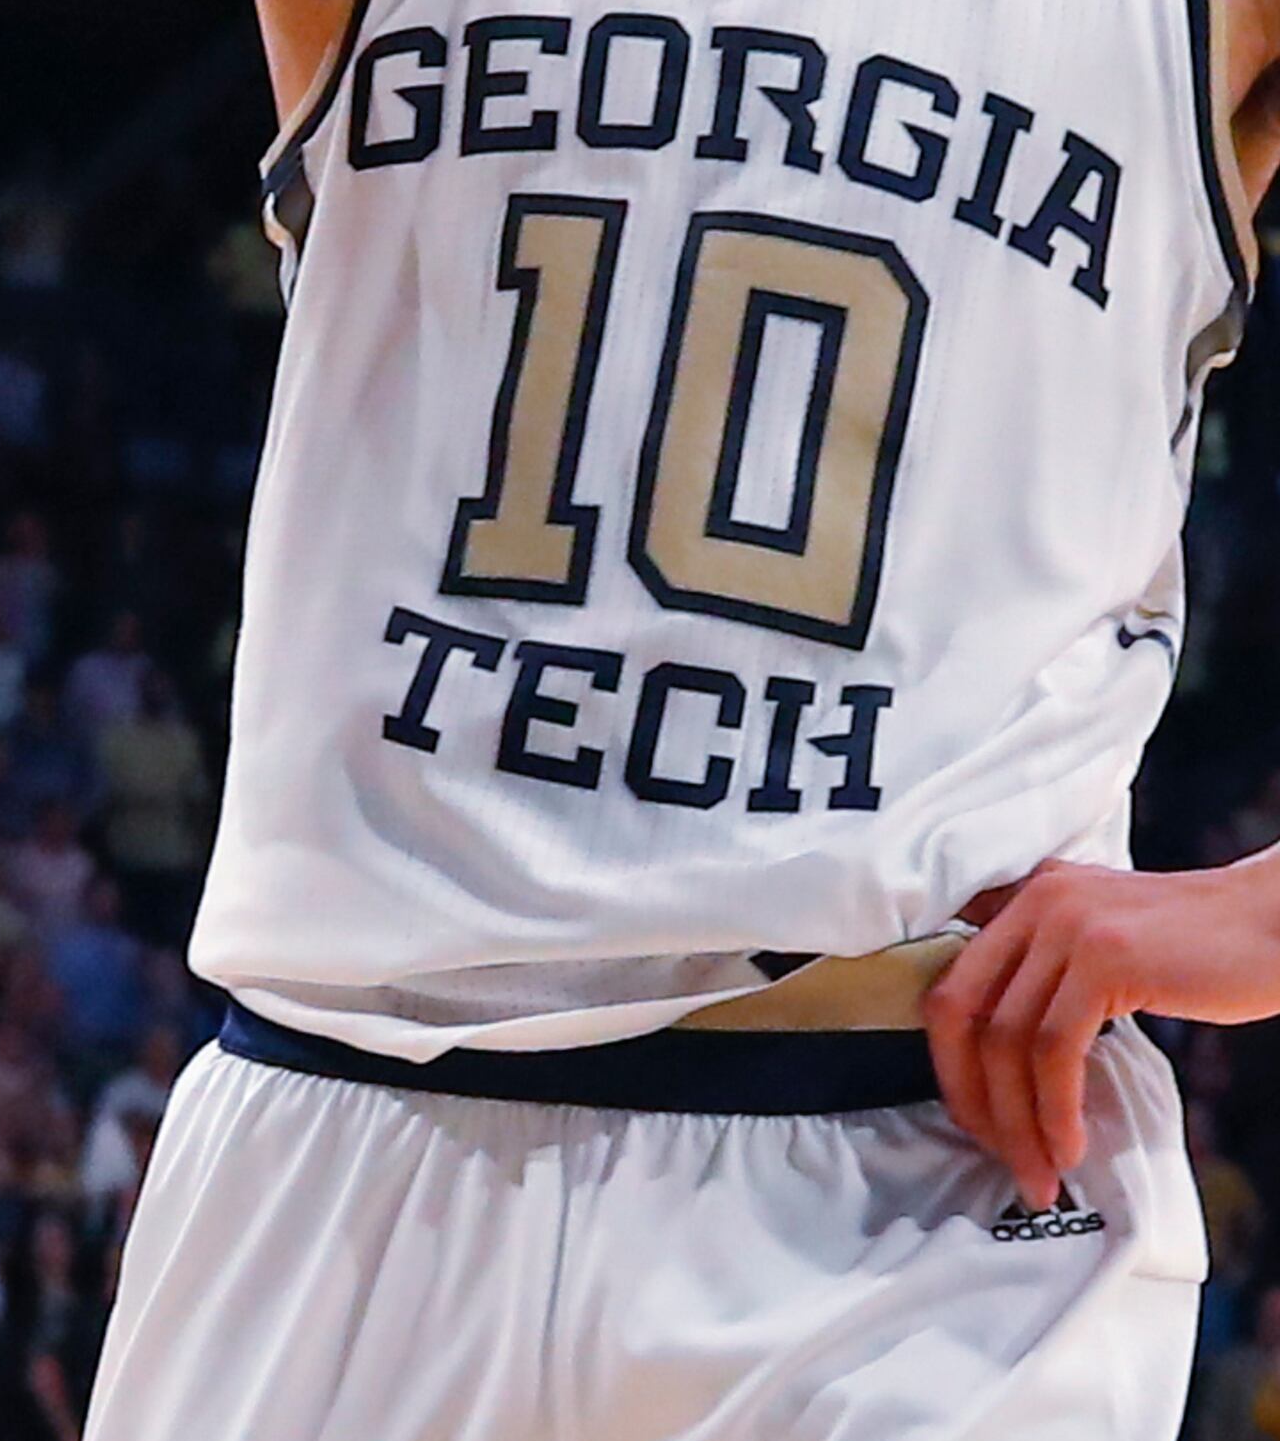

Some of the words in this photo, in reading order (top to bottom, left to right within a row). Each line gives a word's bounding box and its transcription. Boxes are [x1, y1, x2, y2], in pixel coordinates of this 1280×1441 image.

[347, 12, 1122, 310] GEORGIA
[438, 192, 930, 652] 10
[381, 605, 894, 814] TECH
[990, 1209, 1107, 1242] adidas
